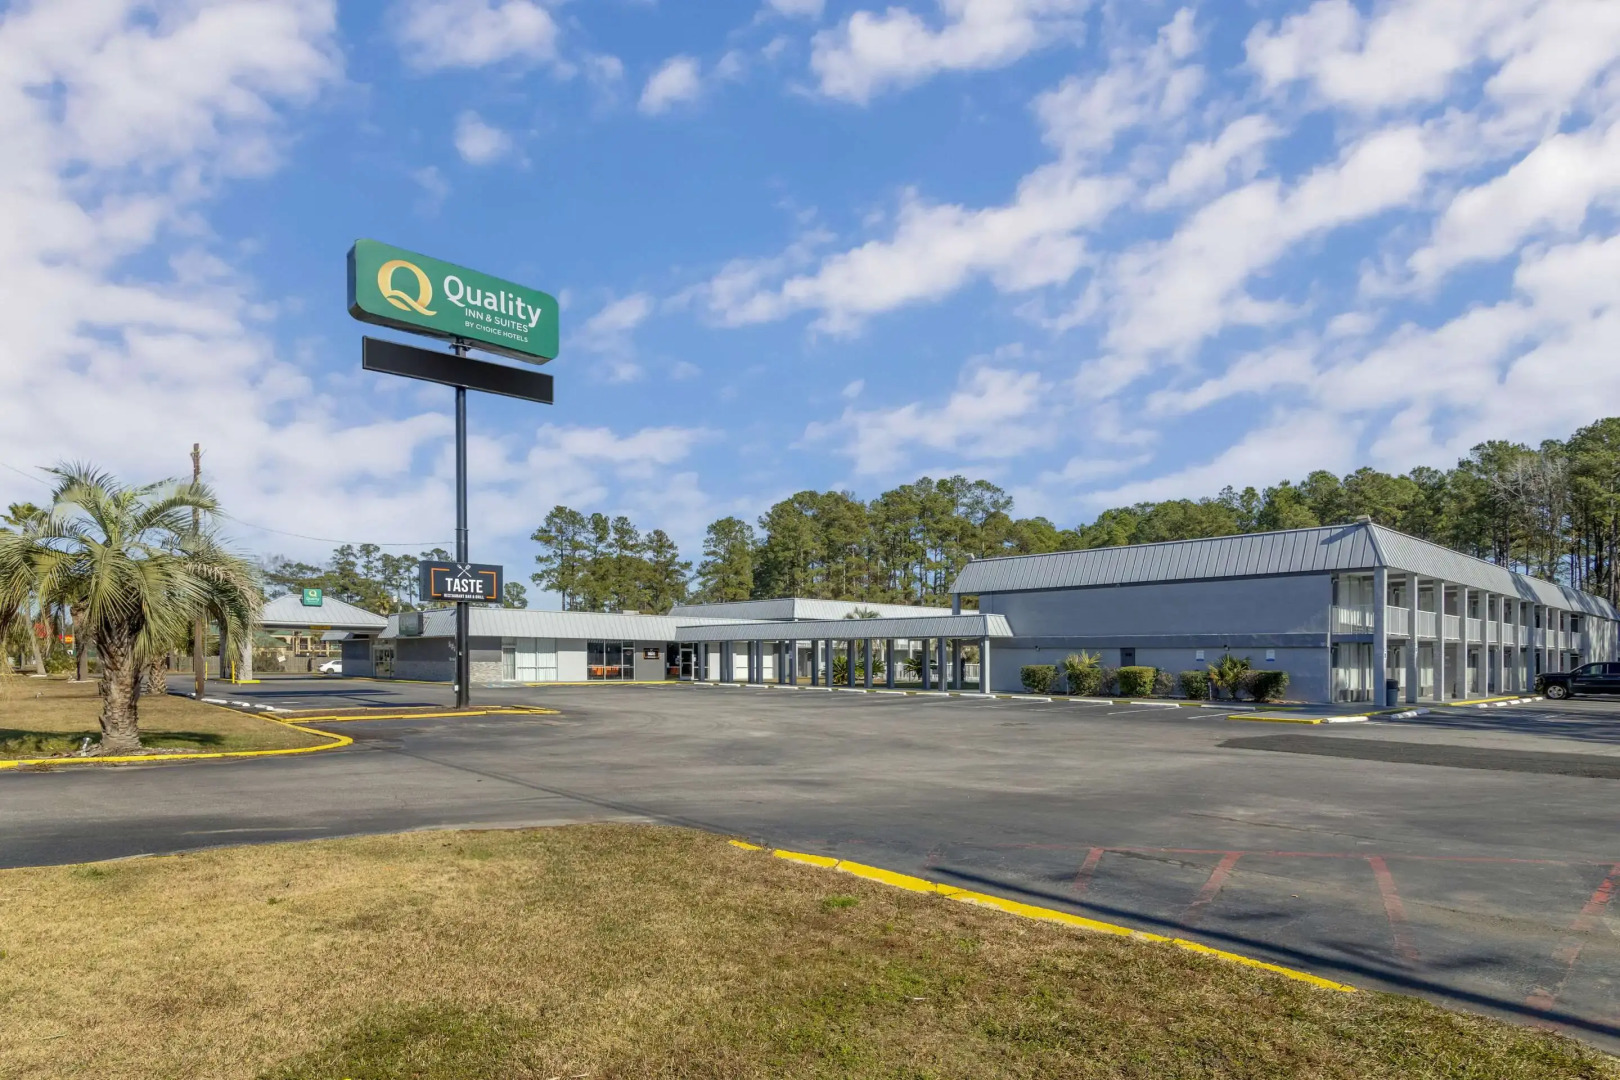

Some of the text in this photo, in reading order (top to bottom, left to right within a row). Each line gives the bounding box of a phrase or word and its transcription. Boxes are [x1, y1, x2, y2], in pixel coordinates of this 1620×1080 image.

[377, 259, 438, 316] Q
[443, 275, 542, 328] Quality
[464, 320, 529, 343] BY CHOICE HOTELS
[465, 307, 529, 333] INN & SUITES
[445, 577, 484, 594] TASTE
